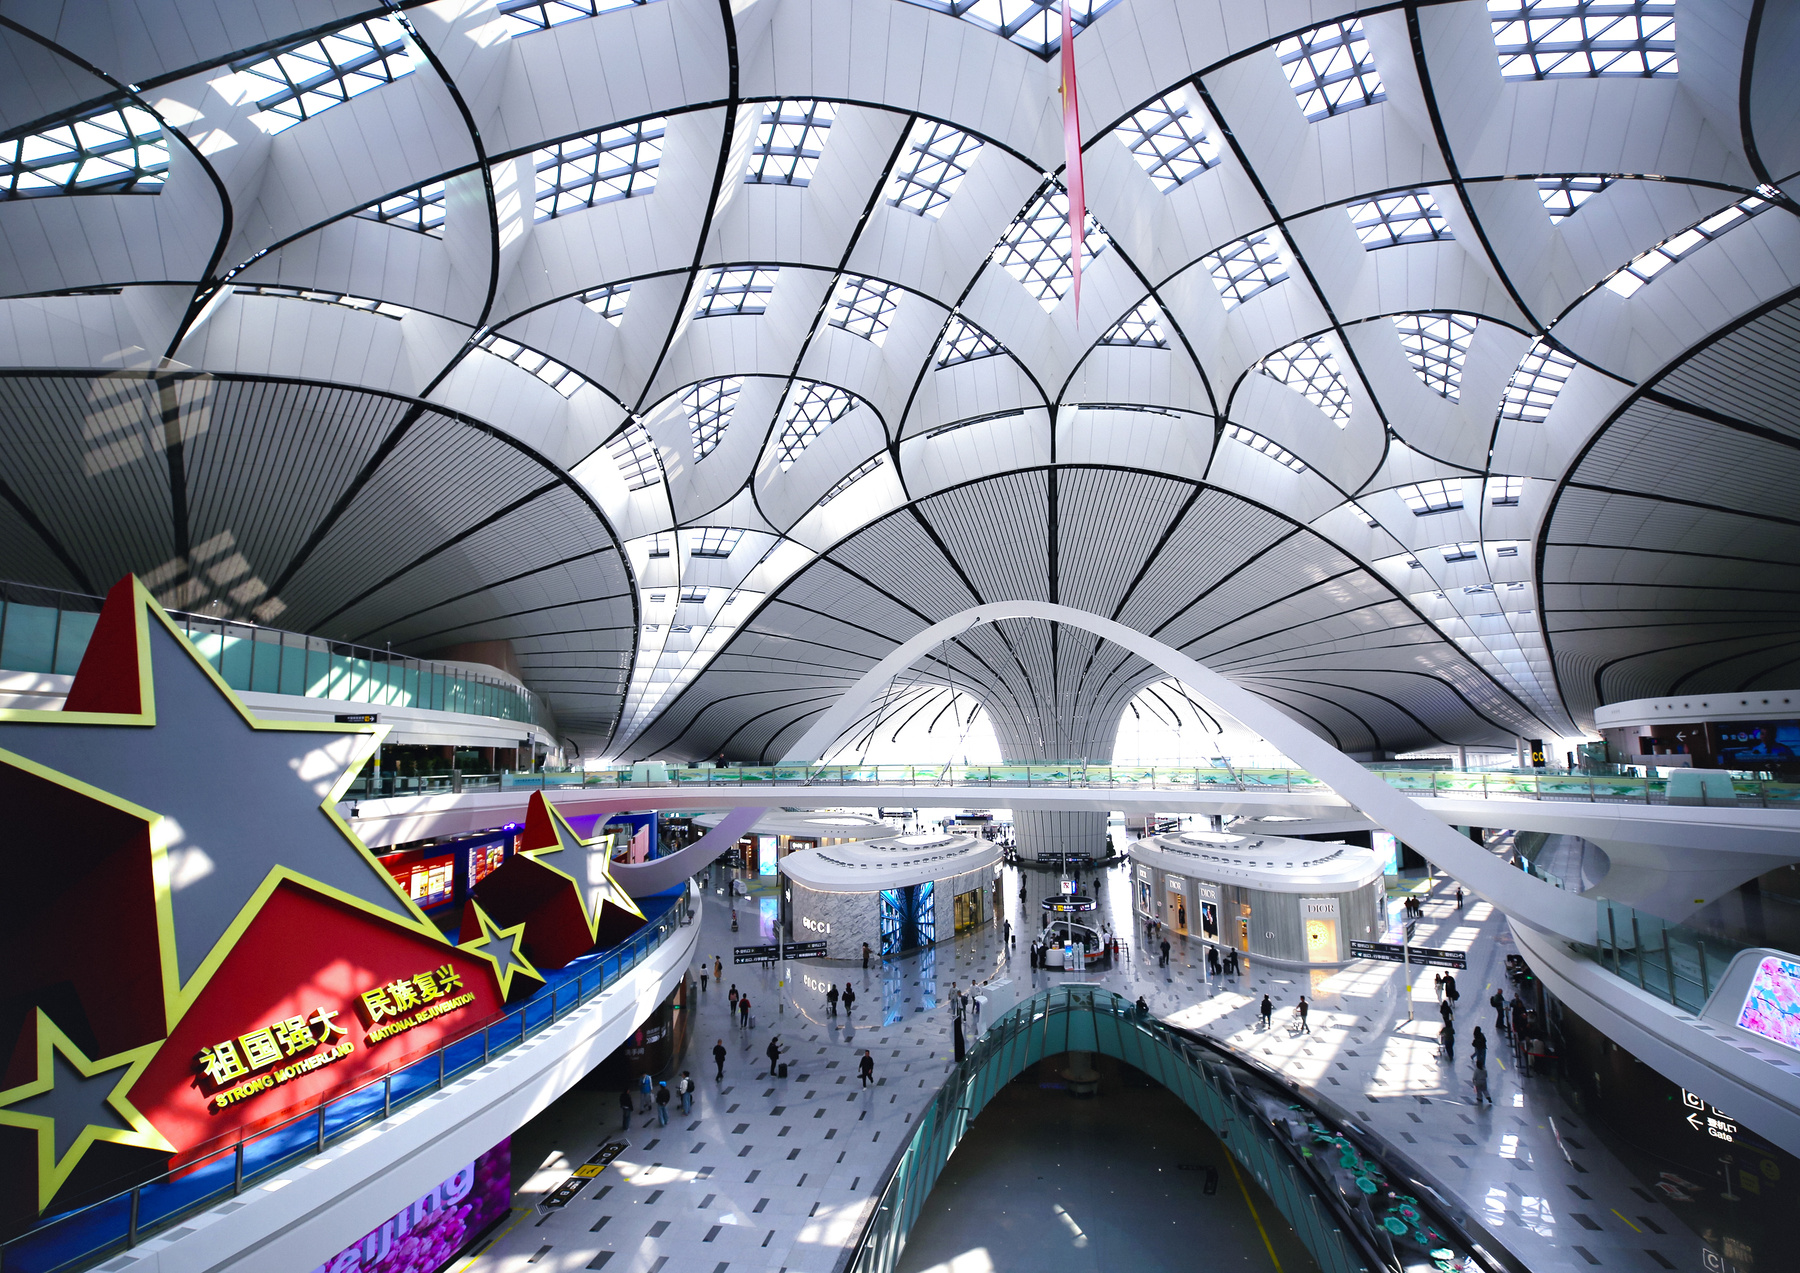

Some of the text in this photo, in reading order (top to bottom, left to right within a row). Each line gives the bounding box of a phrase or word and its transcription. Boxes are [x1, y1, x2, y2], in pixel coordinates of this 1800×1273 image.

[1169, 880, 1182, 891] DIOR
[1200, 887, 1216, 899] DIOR
[1307, 904, 1335, 913] DIOR
[360, 963, 464, 1024] 民族复兴
[368, 992, 476, 1043] NATIONAL REJUVENATION
[199, 1006, 348, 1085] 祖国强大
[215, 1042, 355, 1108] STRONG MOTHERLAND
[1687, 1092, 1700, 1106] C
[1708, 1127, 1733, 1143] Gate
[311, 1161, 475, 1273] eijing
